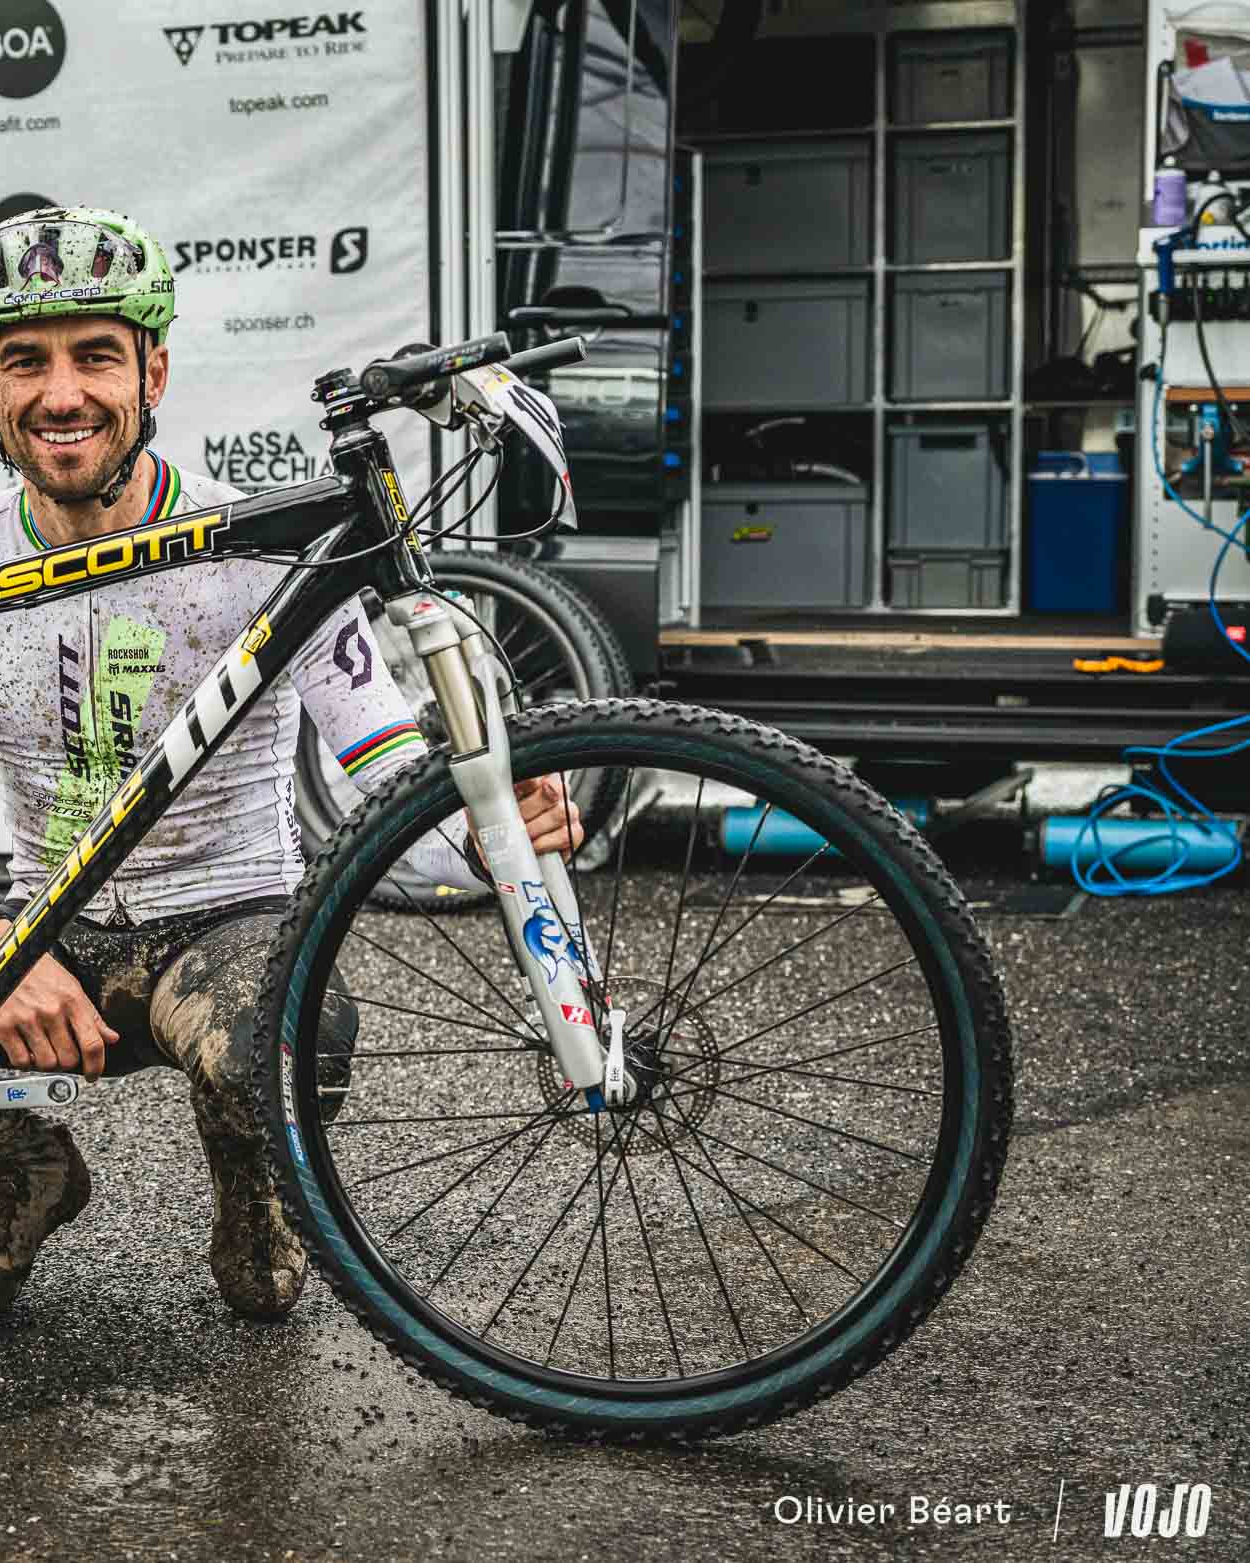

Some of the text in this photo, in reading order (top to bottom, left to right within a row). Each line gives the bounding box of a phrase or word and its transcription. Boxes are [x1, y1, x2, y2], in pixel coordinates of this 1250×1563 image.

[210, 12, 367, 45] TOPEAK
[229, 93, 329, 116] topeak.com
[174, 235, 316, 273] SPONSER
[224, 312, 315, 334] sponser.ch
[204, 430, 304, 457] MASSA
[205, 456, 332, 483] VECCHIA
[381, 469, 423, 555] SCOT
[122, 664, 166, 674] MAXXIS
[109, 690, 137, 781] SRA
